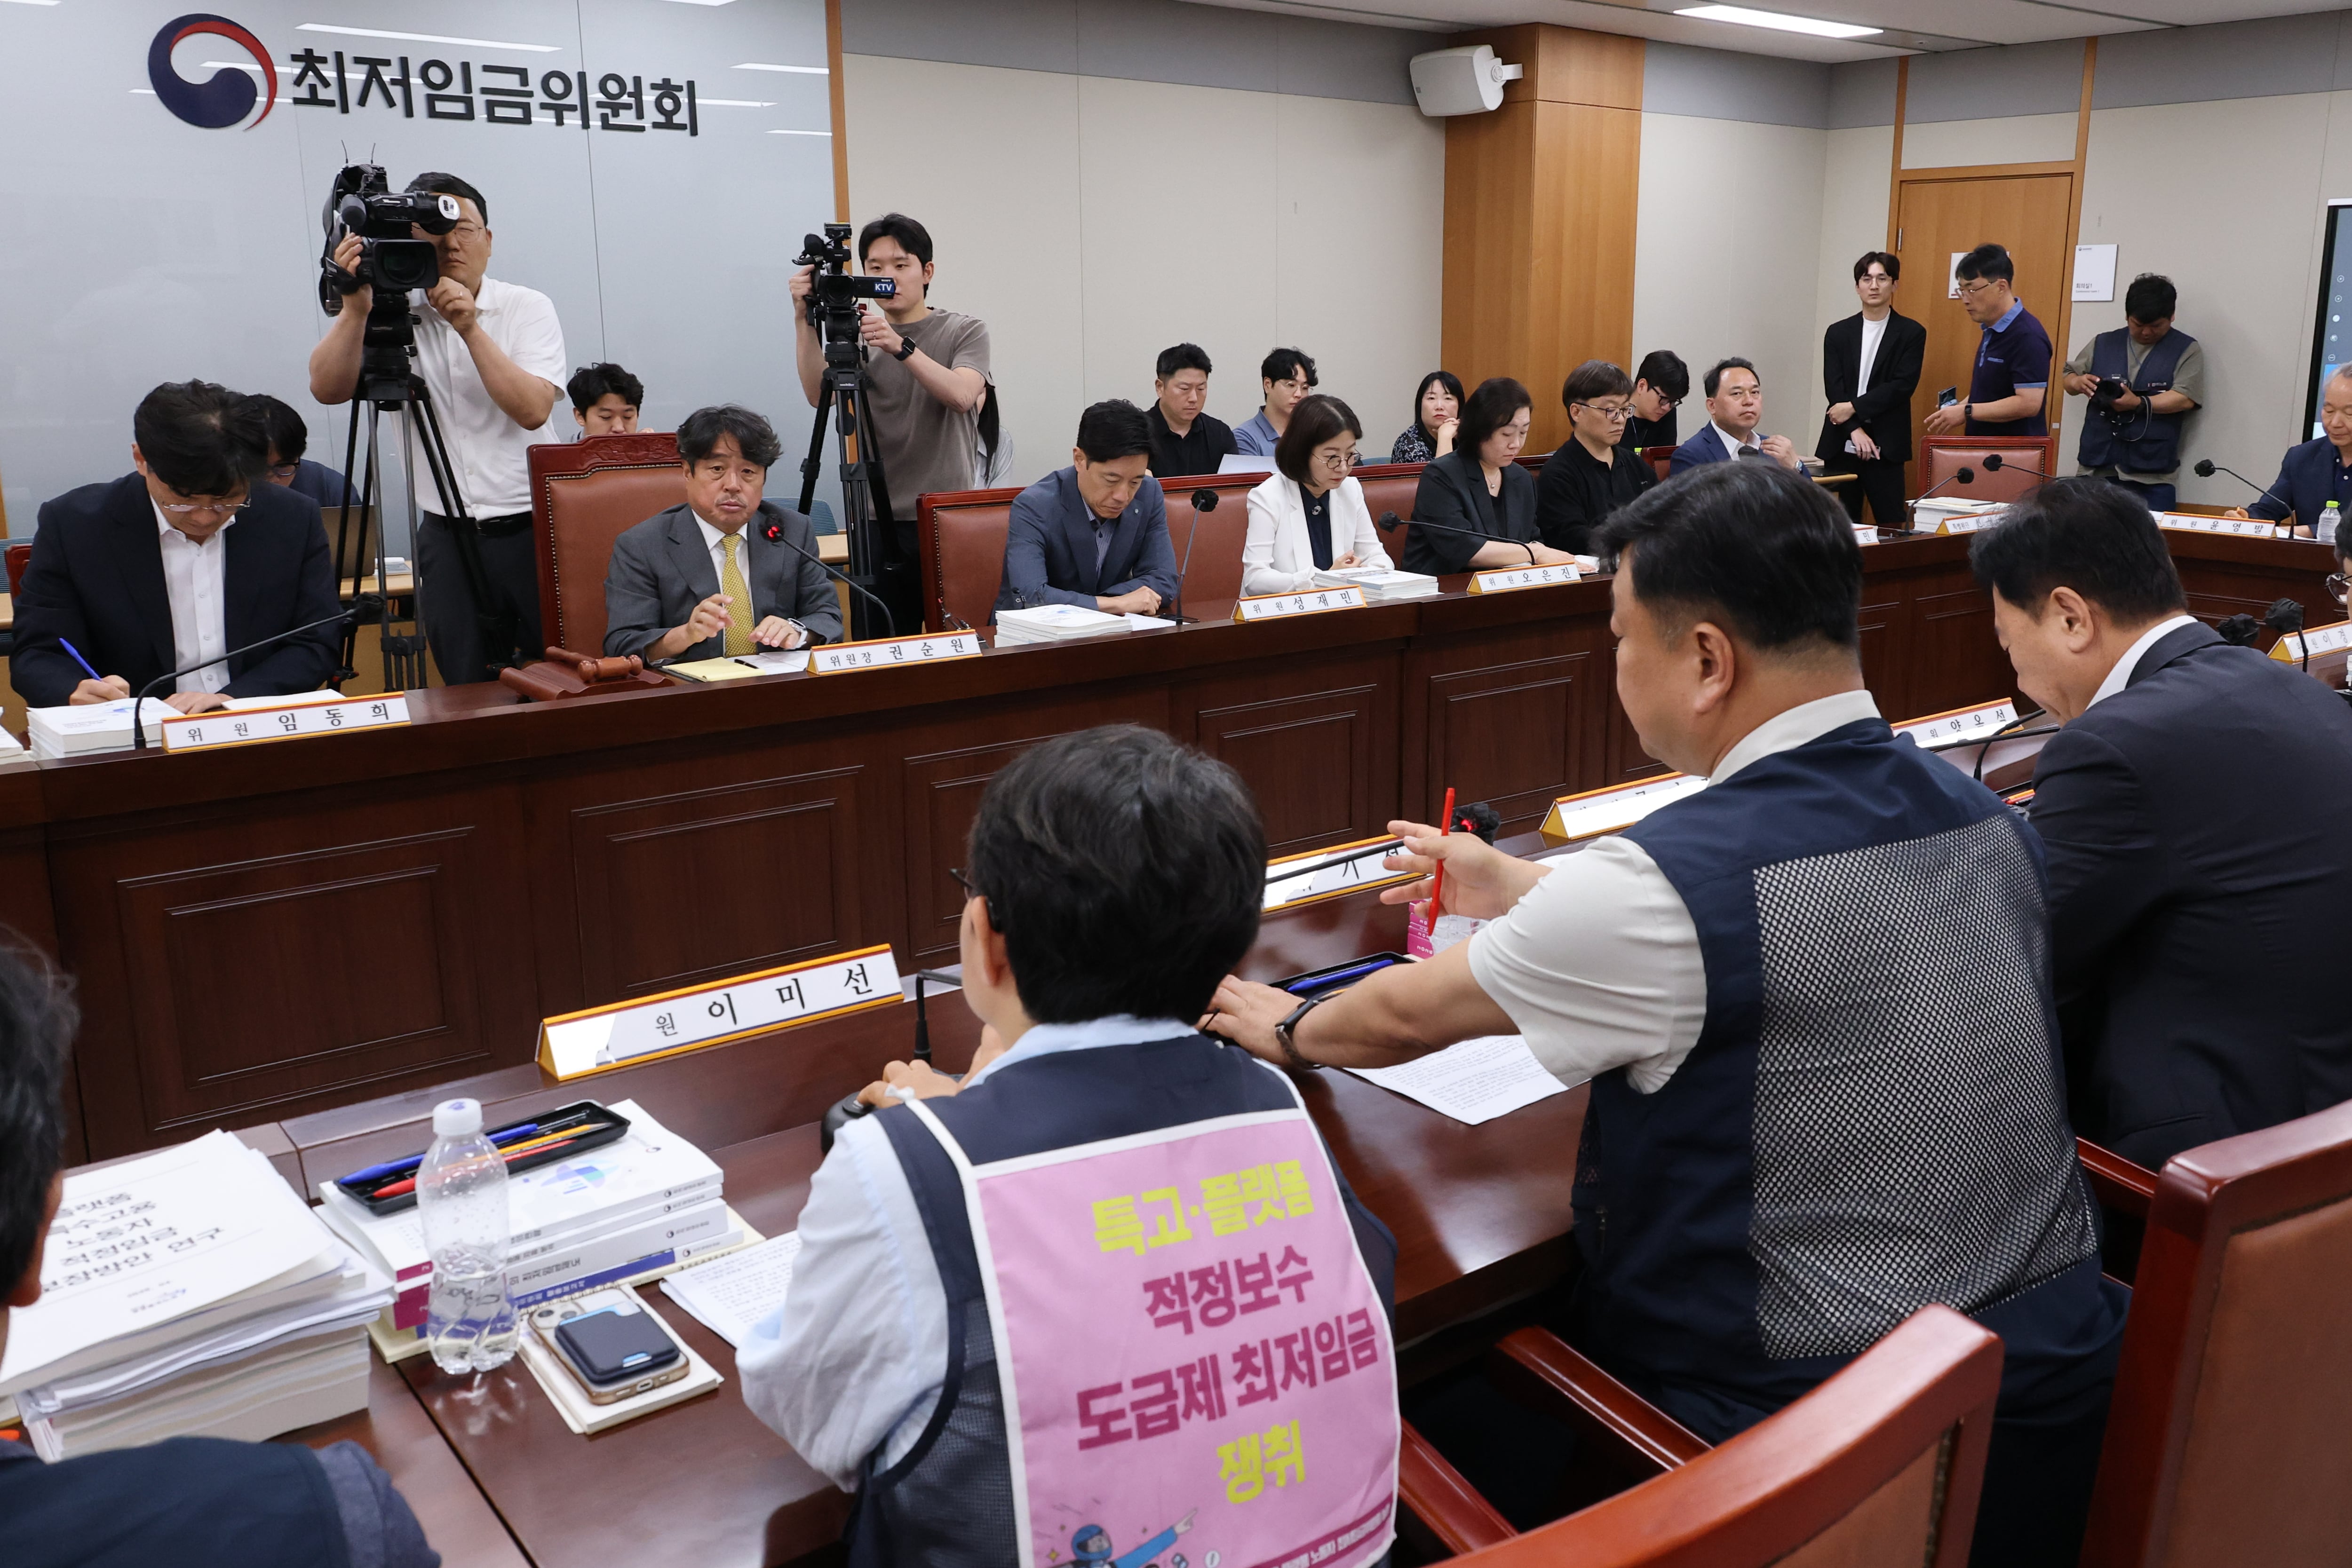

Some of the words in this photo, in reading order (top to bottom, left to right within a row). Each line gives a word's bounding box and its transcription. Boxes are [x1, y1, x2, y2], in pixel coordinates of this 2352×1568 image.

[290, 48, 699, 136] 최저임금위원회
[829, 651, 872, 667] 위원장
[889, 637, 966, 661] 권순원
[66, 1217, 154, 1250] 노동자
[167, 1227, 225, 1253] 연구
[1143, 1245, 1313, 1336] 적정보수
[1076, 1353, 1227, 1451] 도급제
[1232, 1308, 1378, 1406] 최저임금
[1217, 1419, 1307, 1505] 쟁취
